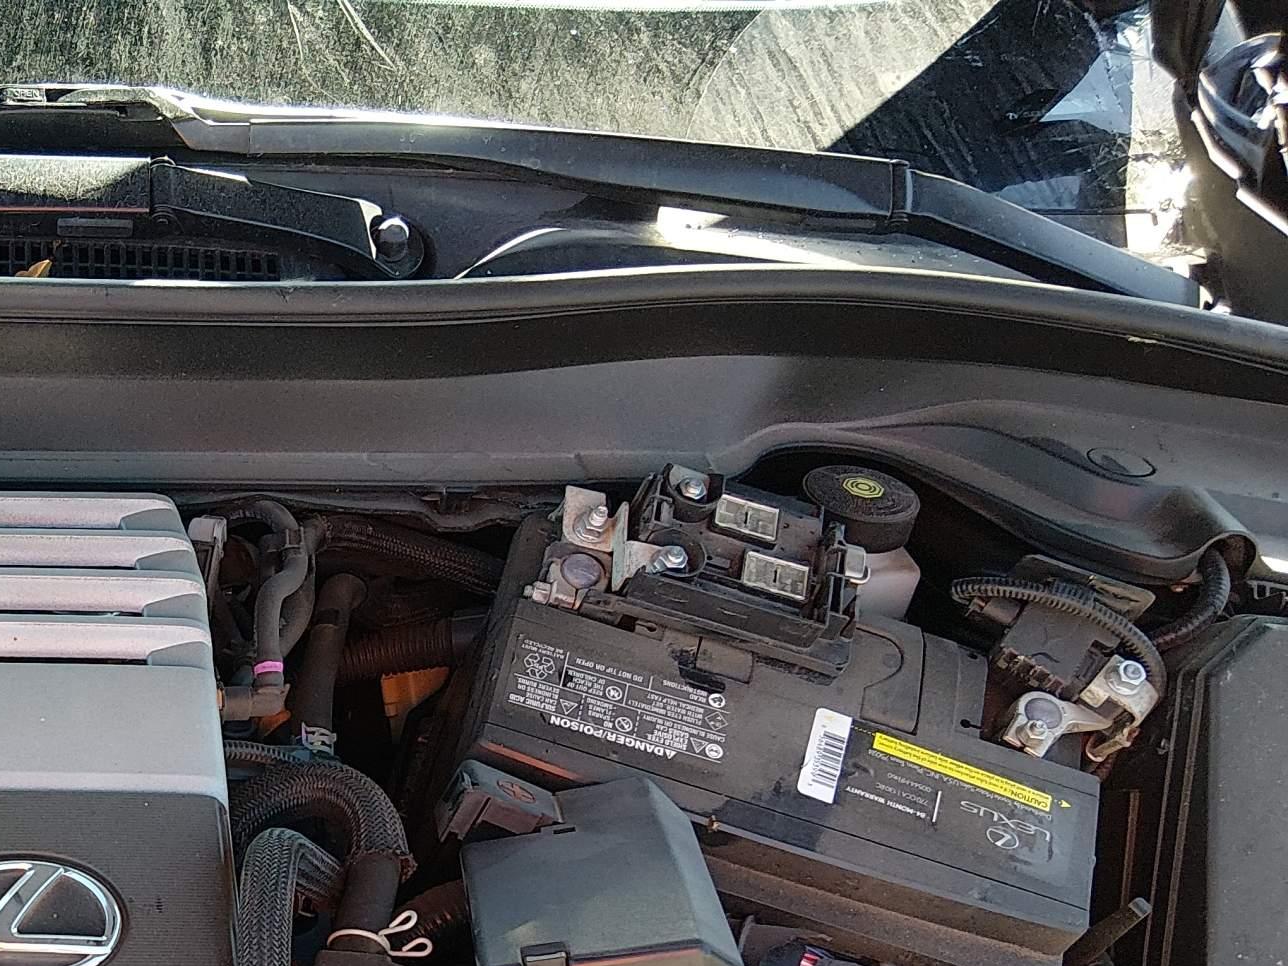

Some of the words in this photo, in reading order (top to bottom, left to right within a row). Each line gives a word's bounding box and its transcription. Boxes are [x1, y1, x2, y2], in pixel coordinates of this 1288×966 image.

[523, 639, 554, 651] RECYCLED
[538, 648, 564, 659] BATTERY
[594, 663, 605, 671] OR
[605, 666, 617, 674] TIP
[617, 670, 632, 679] NOT
[632, 673, 643, 682] DO
[571, 677, 591, 686] REACH
[592, 682, 603, 690] THE
[527, 686, 558, 699] BLINDNESS
[538, 683, 559, 693] SEVERE
[588, 688, 602, 696] KEEP
[508, 693, 525, 702] ACID
[525, 691, 544, 701] CAUSE
[662, 696, 677, 705] HELP
[688, 693, 706, 702] READ
[525, 697, 556, 711] SULFURIC
[586, 697, 612, 708] SMOKING
[627, 698, 666, 714] IMMEDIATELY
[678, 701, 704, 713] MEDICAL
[588, 704, 611, 714] FLAMES
[587, 709, 610, 720] SPARKS
[666, 710, 681, 719] EYES
[686, 710, 703, 719] WITH
[682, 715, 701, 725] FLUSH
[655, 723, 667, 731] CAN
[673, 723, 705, 736] BLINDNESS
[549, 715, 664, 756] DANGER/POISON
[652, 729, 687, 744] EXPLOSIVE
[668, 727, 689, 738] GASES
[705, 732, 725, 742] CAUSE
[663, 738, 687, 750] SHIELD
[845, 785, 885, 804] WARRANTY
[959, 800, 1050, 841] LEXUS
